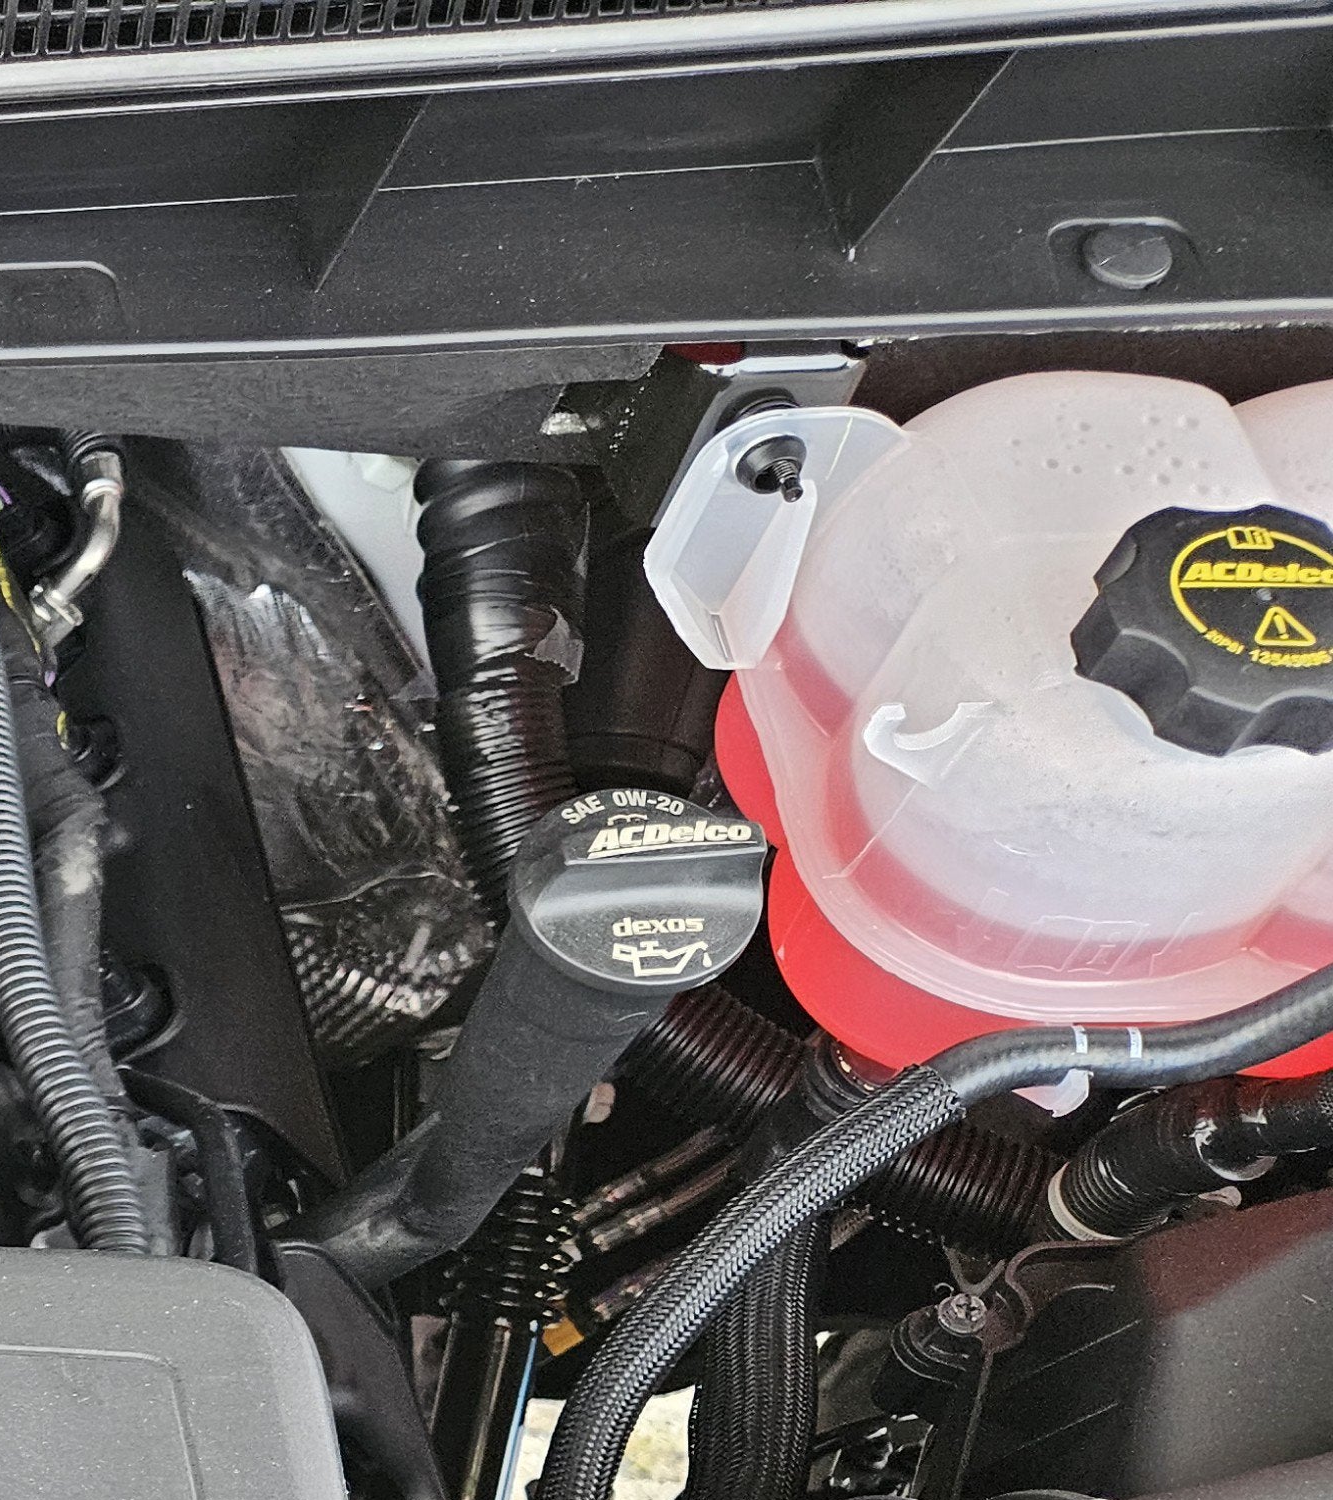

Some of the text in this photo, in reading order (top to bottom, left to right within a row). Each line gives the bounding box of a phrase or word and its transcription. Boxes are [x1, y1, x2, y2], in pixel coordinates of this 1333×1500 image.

[561, 790, 684, 825] SAE 0W-20
[587, 820, 752, 852] ACDelco
[612, 917, 705, 937] dexos
